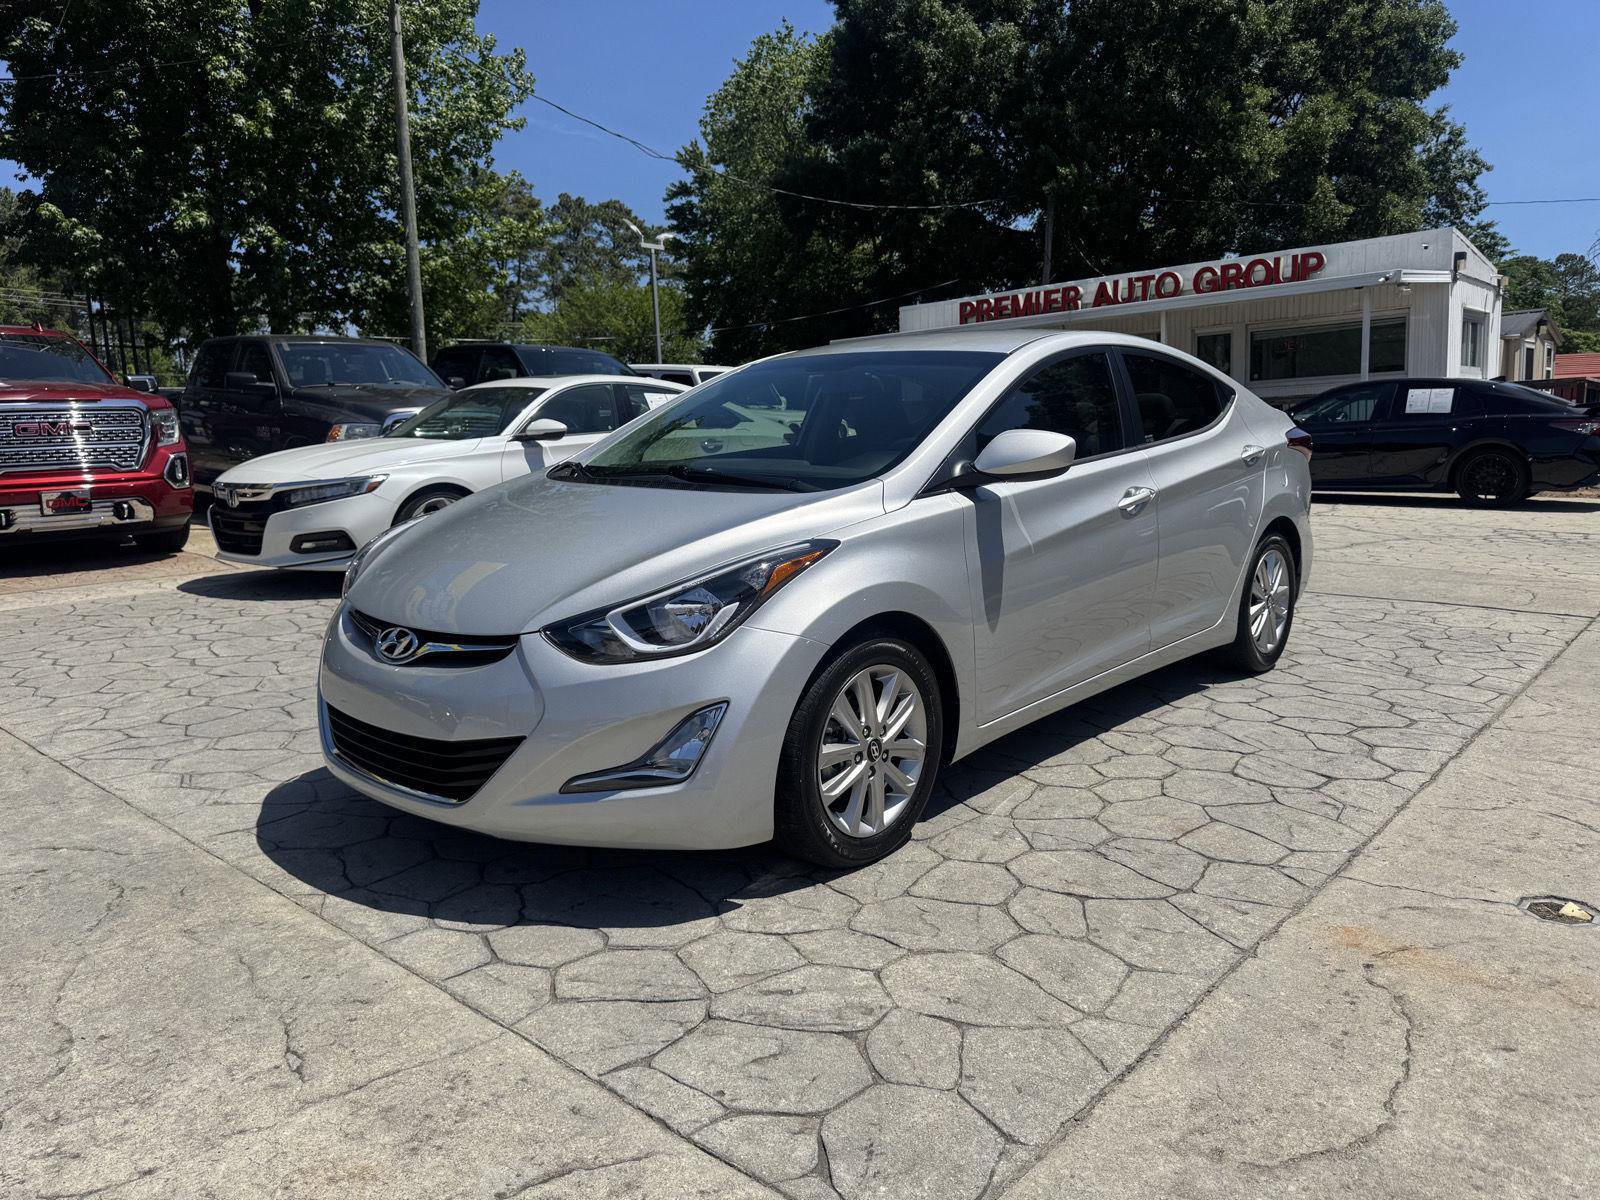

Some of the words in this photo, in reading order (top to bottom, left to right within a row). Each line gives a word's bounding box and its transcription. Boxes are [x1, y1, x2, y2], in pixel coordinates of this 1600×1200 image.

[959, 286, 1081, 325] PREMIER
[1092, 271, 1183, 308] AUTO
[1193, 251, 1327, 295] GROUP
[15, 421, 91, 436] GMC
[46, 497, 88, 508] GMC
